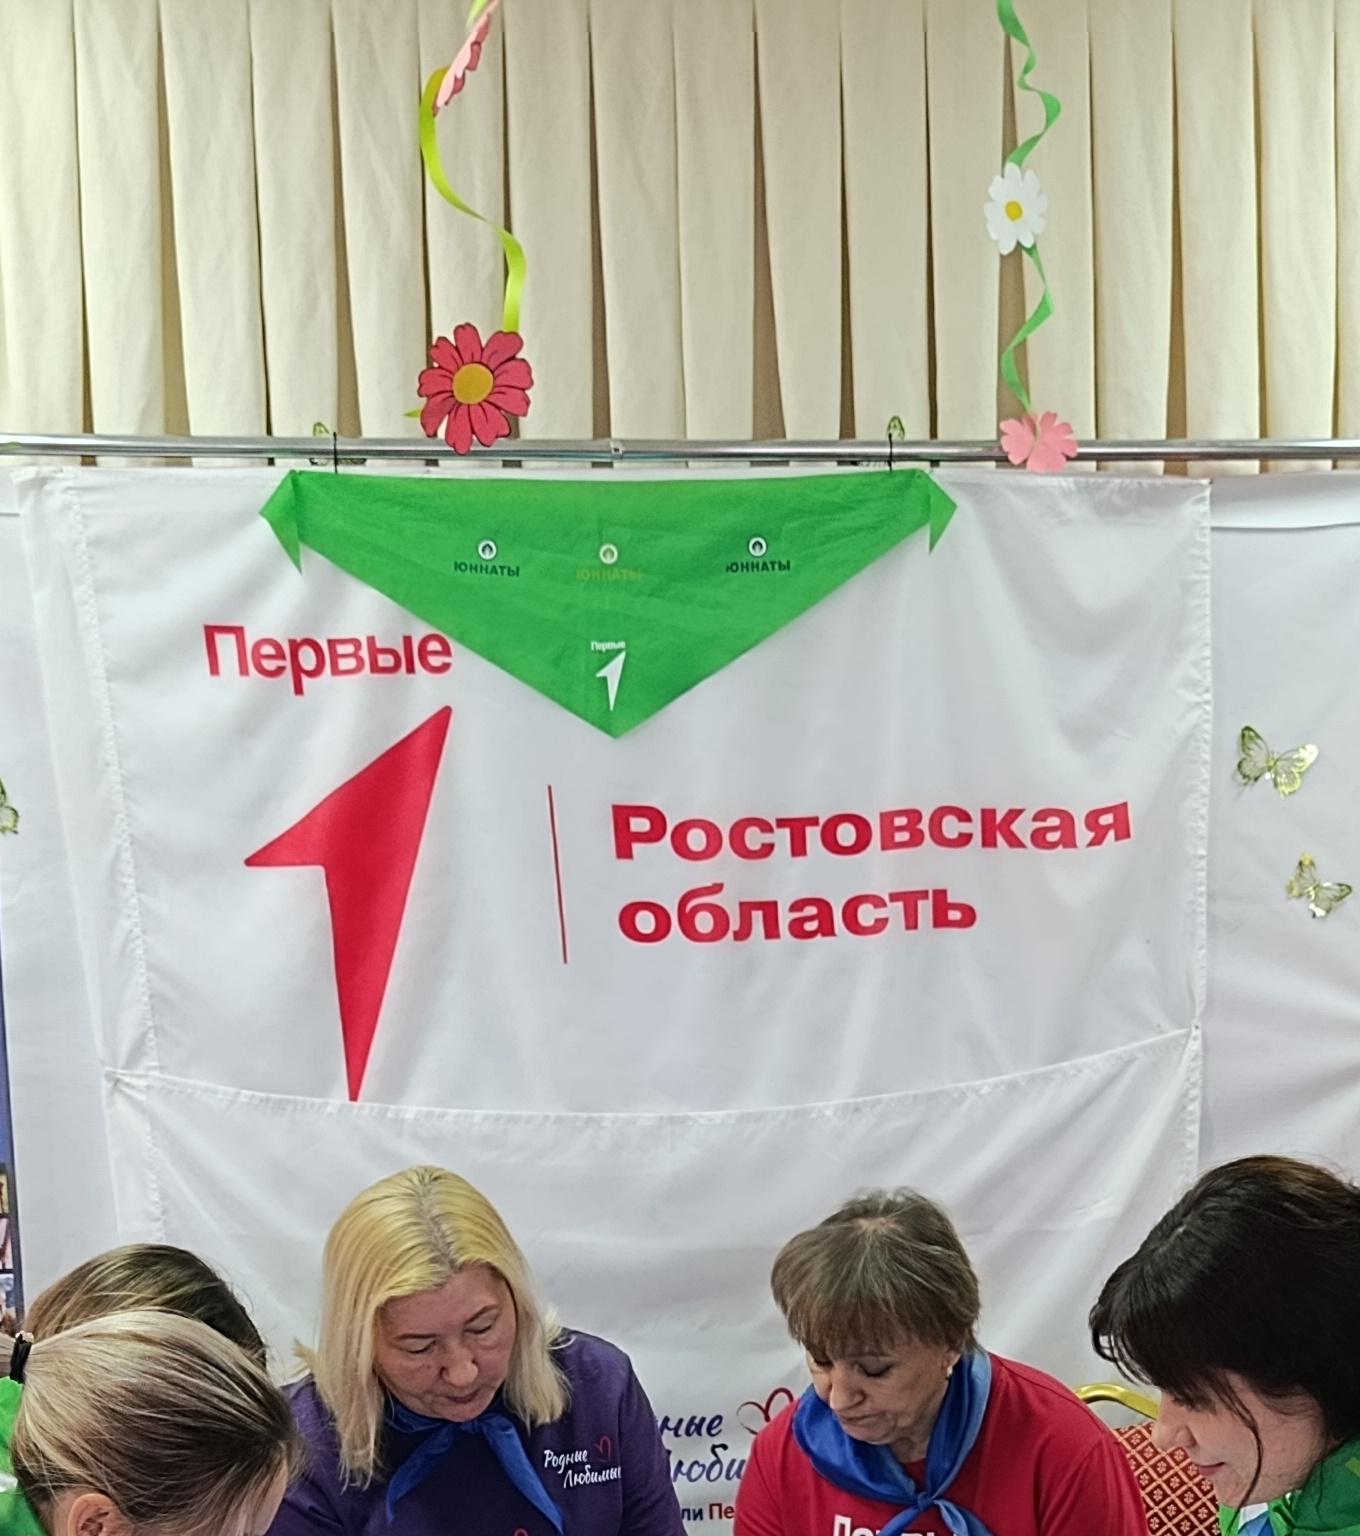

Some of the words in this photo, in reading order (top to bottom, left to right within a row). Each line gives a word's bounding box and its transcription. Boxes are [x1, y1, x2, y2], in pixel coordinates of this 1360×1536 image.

[454, 561, 520, 577] ЮННАТЫ
[726, 560, 791, 574] ЮННАТЫ
[591, 640, 626, 652] Первые
[202, 622, 453, 696] Первые
[610, 801, 1131, 863] Ростовская
[617, 880, 977, 944] область
[544, 1449, 588, 1474] Родные
[563, 1464, 621, 1488] Любимы
